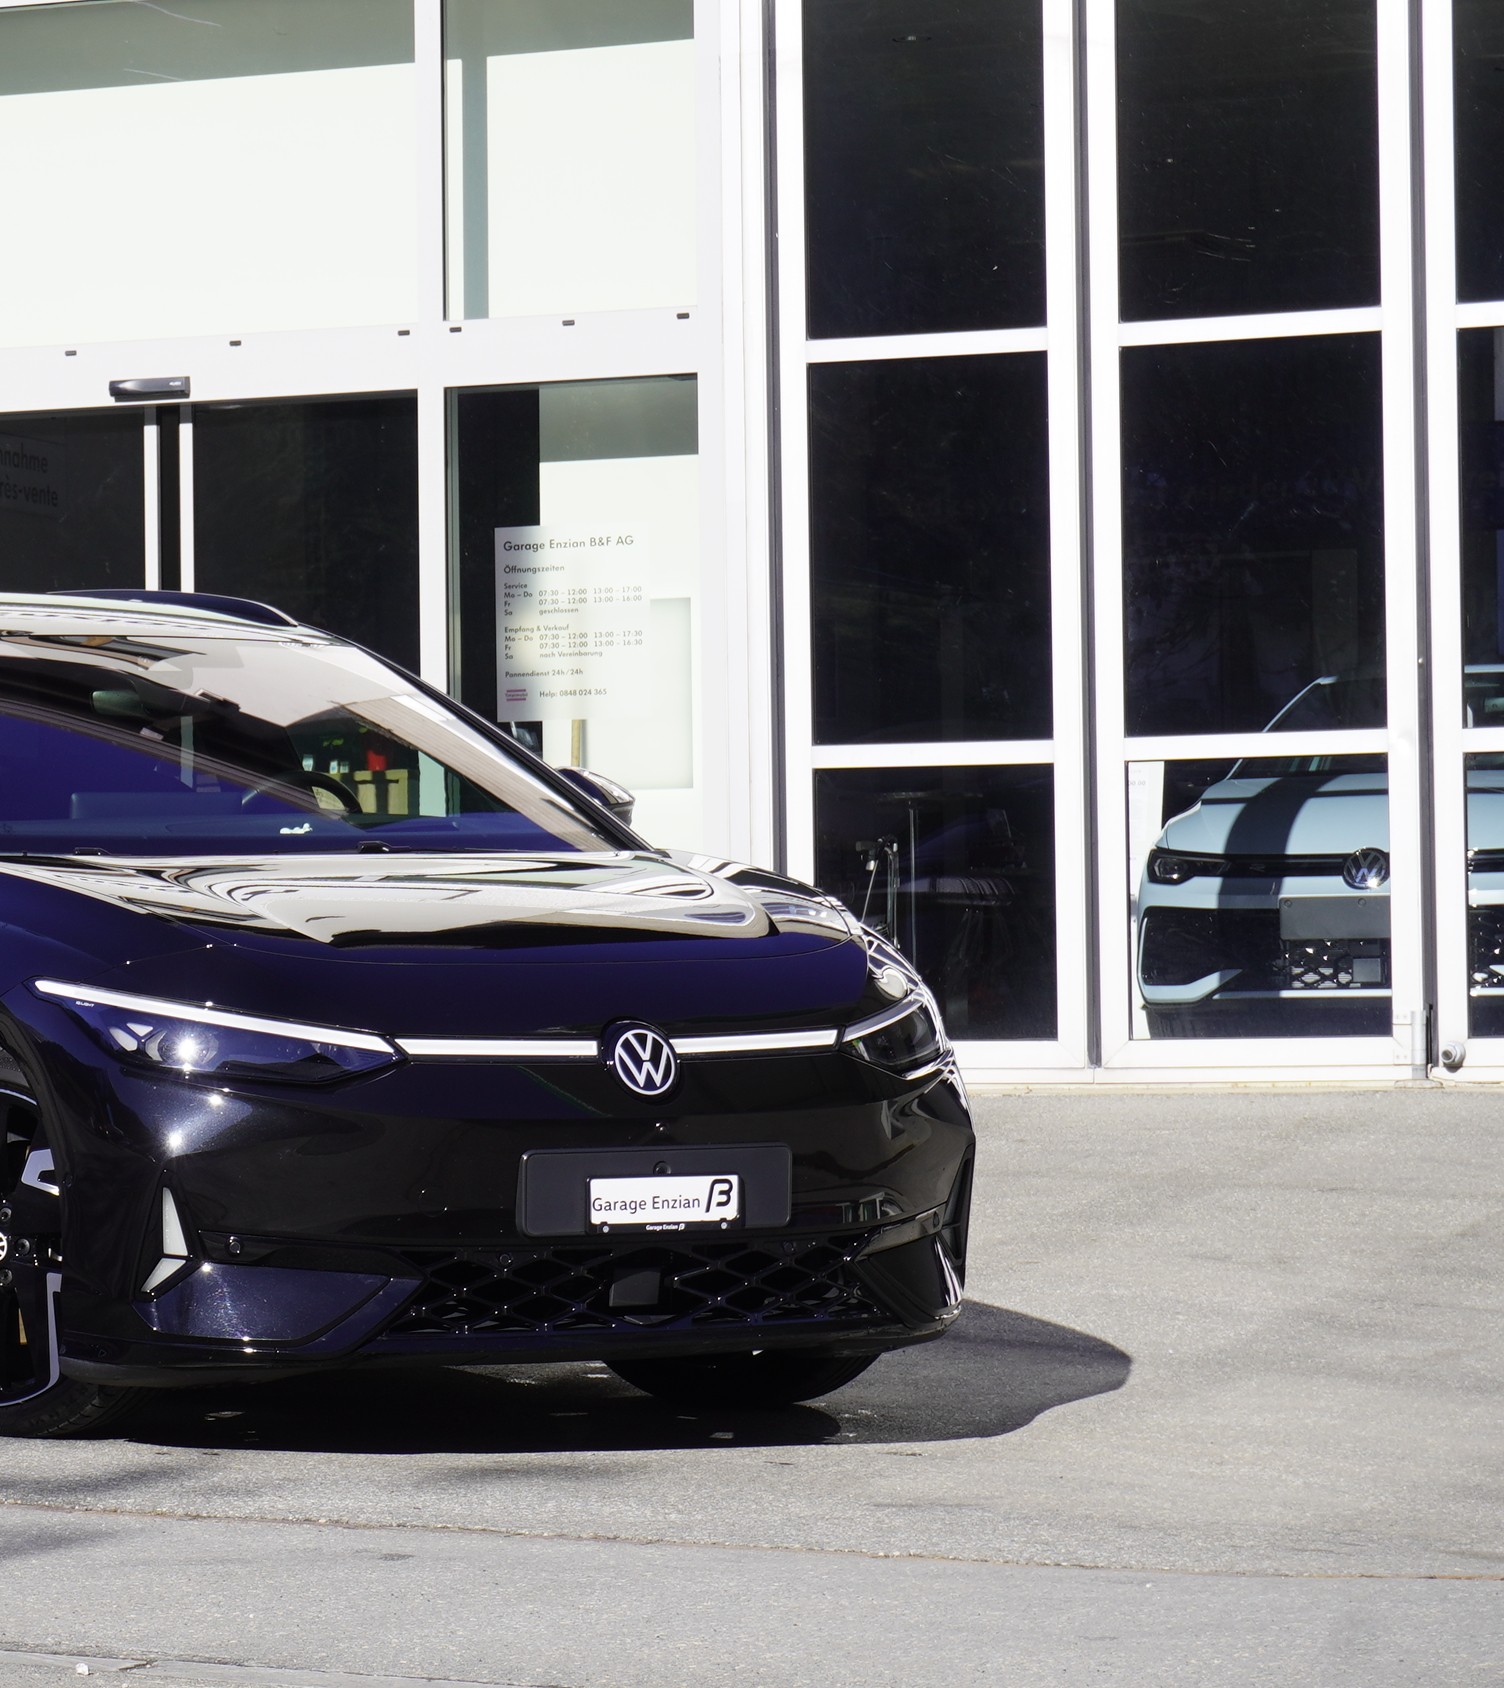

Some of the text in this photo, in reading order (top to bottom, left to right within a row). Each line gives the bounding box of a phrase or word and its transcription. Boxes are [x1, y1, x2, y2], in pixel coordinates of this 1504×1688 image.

[503, 535, 634, 553] Garage Enzian B&F AG
[503, 563, 565, 575] Öffnungszeiten
[503, 582, 528, 590] Service
[538, 590, 559, 598] 07:30
[567, 588, 587, 596] 12:00
[503, 600, 511, 608] Fr
[538, 598, 559, 606] 07:30
[567, 597, 587, 605] 12:00
[538, 607, 579, 616] geschlossen
[504, 625, 534, 635] Empfang
[543, 624, 570, 632] Verkauf
[504, 635, 516, 643] Mo
[568, 632, 588, 640] 12:00
[594, 631, 614, 639] 13:00
[539, 642, 560, 650] 07:30
[558, 649, 603, 658] Vereinbarung
[504, 670, 550, 679] Pannendienst
[539, 688, 607, 700] Help: 0848 024 365
[592, 1197, 647, 1214] Garage
[652, 1194, 700, 1210] Enzian
